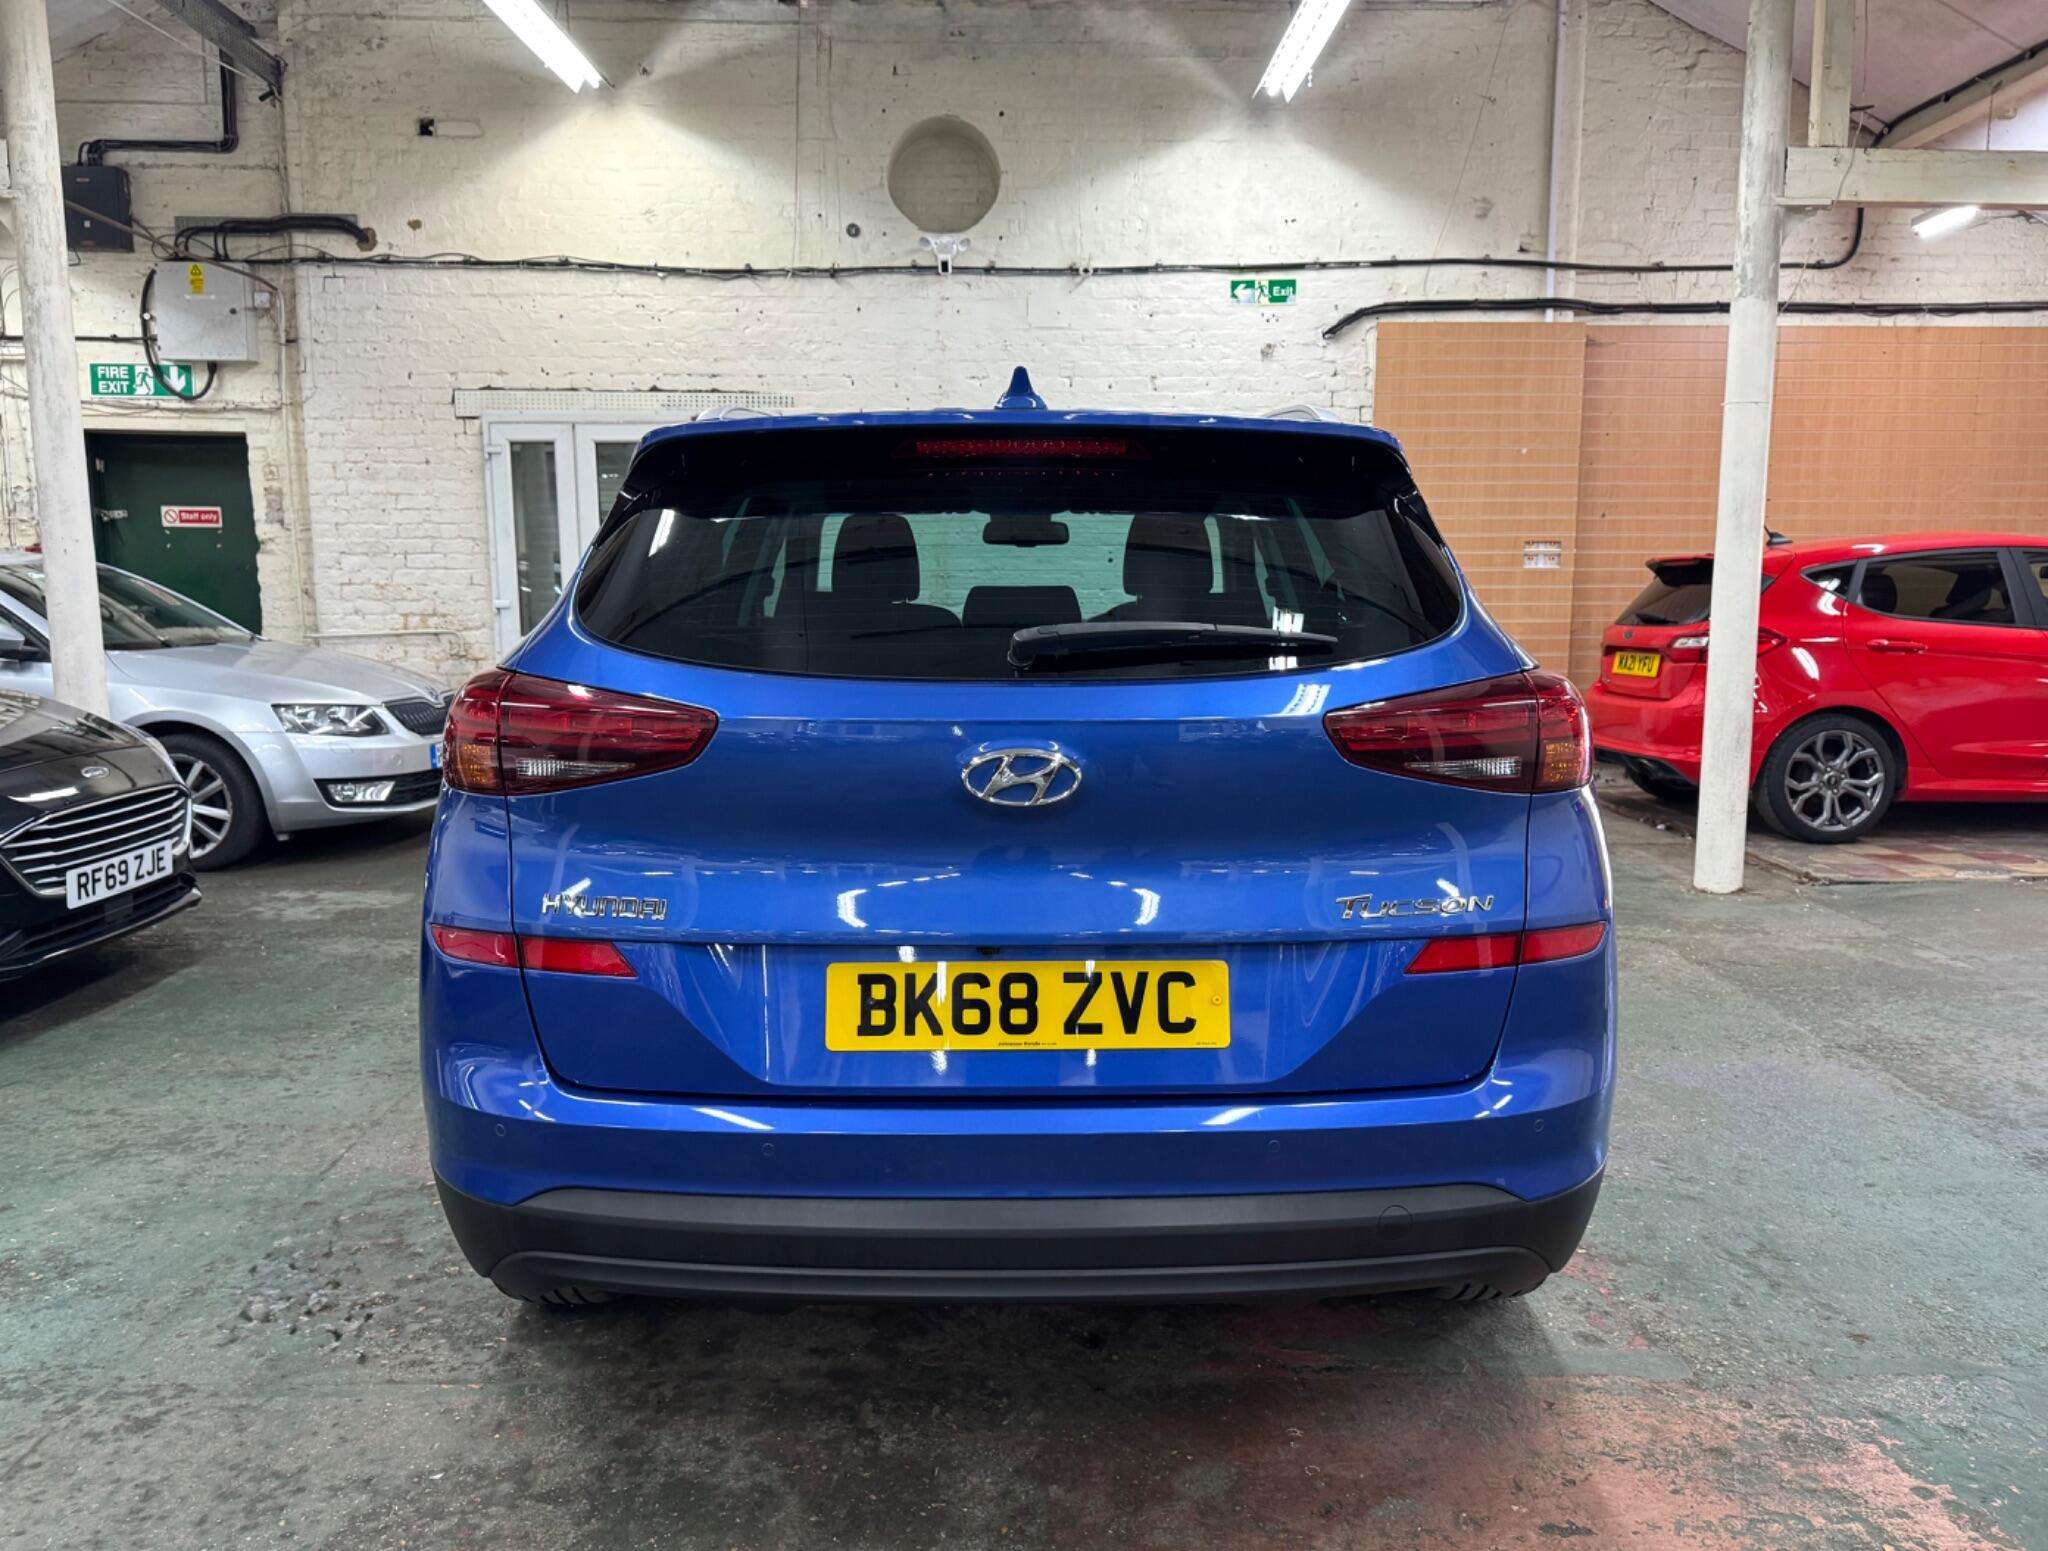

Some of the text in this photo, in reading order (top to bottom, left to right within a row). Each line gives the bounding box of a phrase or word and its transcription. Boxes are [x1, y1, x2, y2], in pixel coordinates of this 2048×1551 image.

[1272, 286, 1293, 296] Exit
[97, 366, 129, 379] FIRE
[98, 381, 129, 393] EXIT
[180, 511, 217, 522] Staff only
[77, 846, 166, 900] RF69 ZJE
[541, 892, 668, 920] HYUNDAI
[1335, 893, 1495, 919] TUCSON
[857, 970, 1197, 1036] BK68 ZVC
